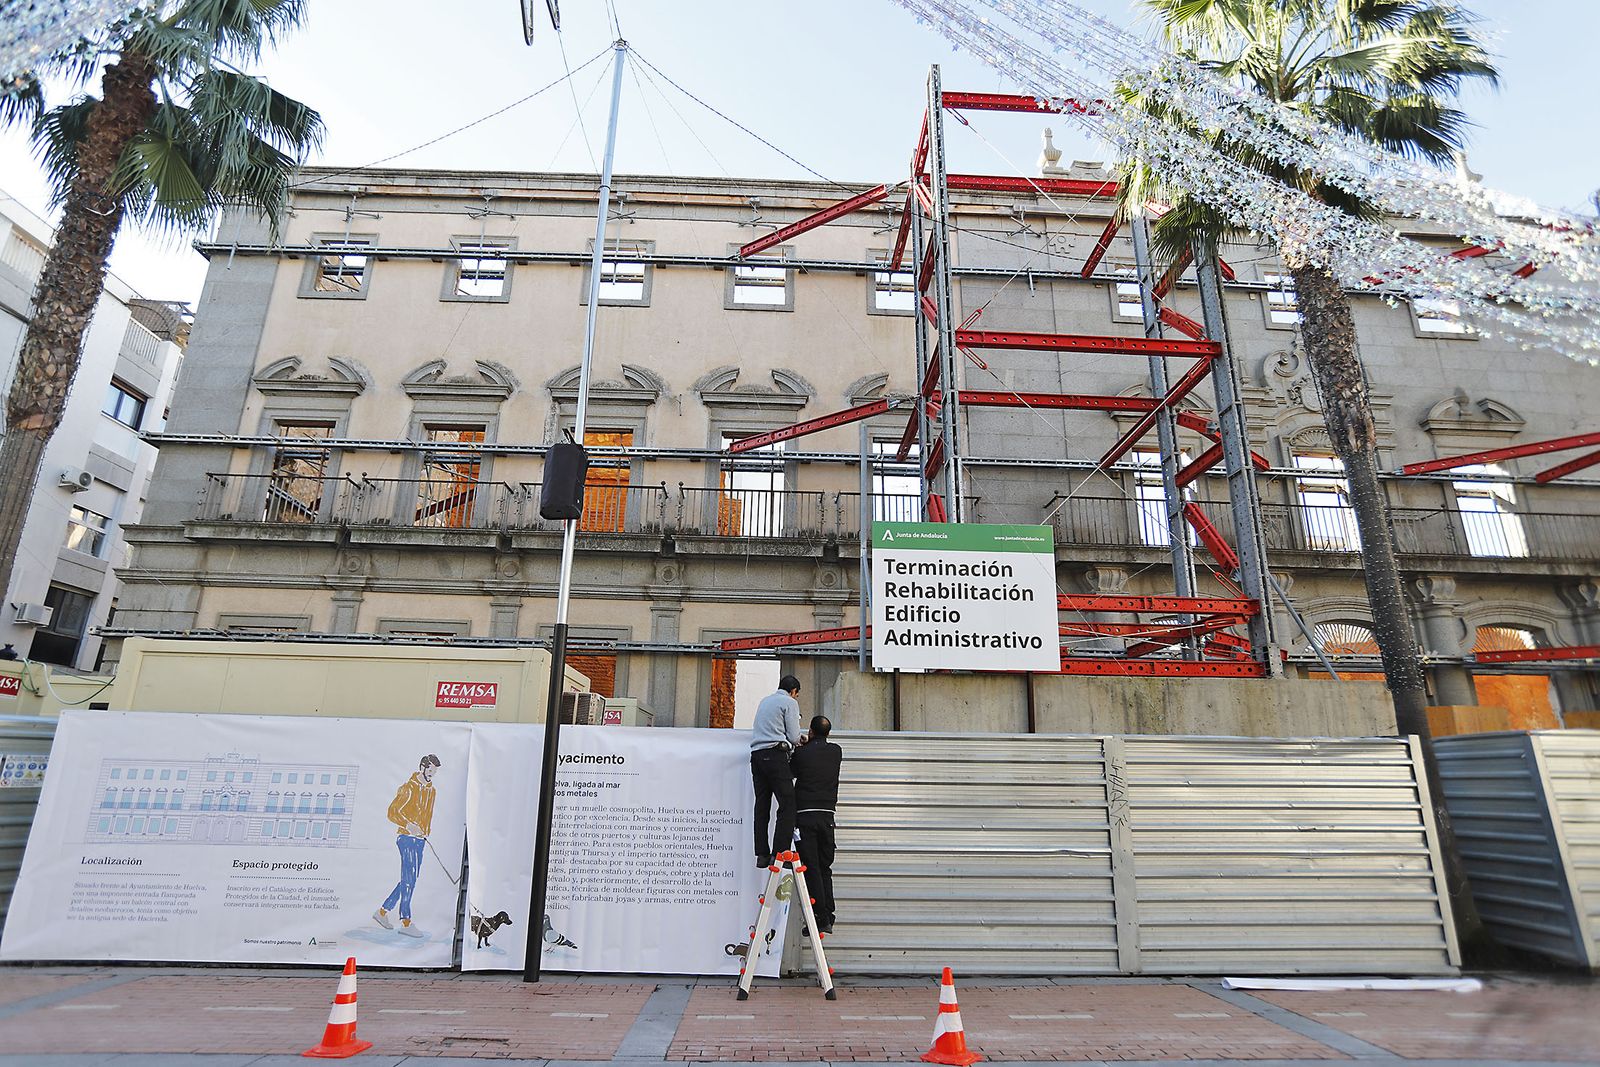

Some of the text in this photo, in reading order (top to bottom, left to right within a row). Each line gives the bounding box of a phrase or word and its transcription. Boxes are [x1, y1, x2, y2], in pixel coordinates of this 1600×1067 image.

[884, 558, 1013, 578] Terminación
[885, 582, 1034, 602] Rehabilitación
[886, 605, 961, 623] Edificio
[884, 628, 1042, 649] Administrativo
[439, 684, 496, 697] REMSA
[572, 780, 596, 789] ligada
[610, 805, 656, 815] cosmopolita,
[706, 808, 730, 817] puerto
[672, 816, 698, 824] inicios,
[558, 821, 612, 830] interrelaciona
[670, 824, 720, 832] comerciantes
[602, 831, 630, 840] puertos
[673, 833, 700, 842] lejanas
[634, 841, 662, 850] pueblos
[664, 842, 704, 851] orientales,
[550, 848, 579, 857] antigua
[660, 851, 697, 859] tartéssico,
[81, 856, 142, 866] Localización
[232, 860, 318, 872] Espacio protegido
[636, 859, 674, 869] capacidad
[549, 866, 566, 874] ales,
[568, 866, 599, 876] primero
[636, 868, 668, 877] después,
[701, 870, 720, 879] plata
[580, 876, 640, 886] posteriormente,
[269, 886, 296, 894] Catálogo
[547, 884, 570, 893] utica,
[646, 887, 674, 896] figuras
[226, 893, 258, 902] Protegidos
[278, 894, 302, 902] Ciudad,
